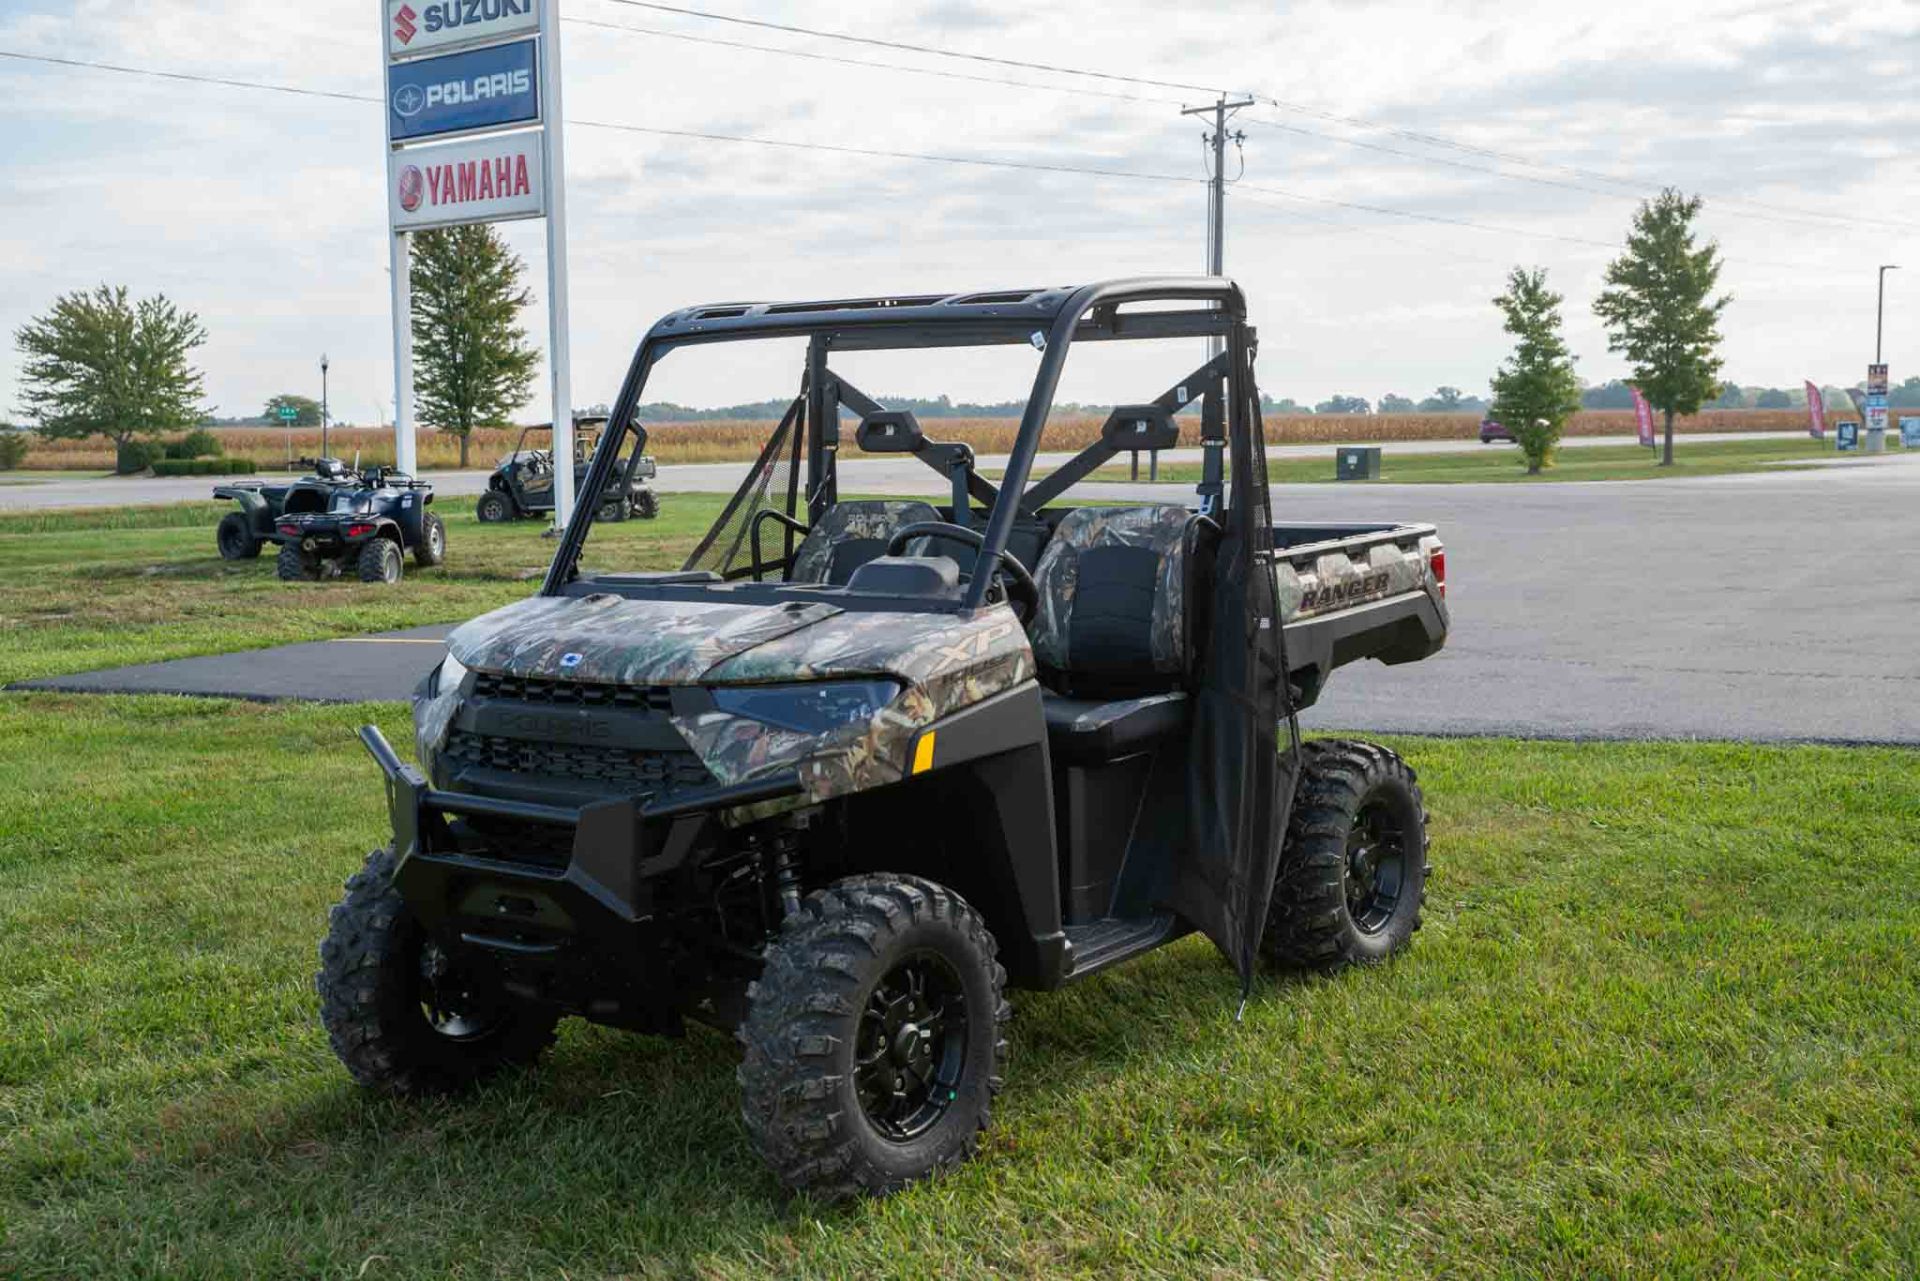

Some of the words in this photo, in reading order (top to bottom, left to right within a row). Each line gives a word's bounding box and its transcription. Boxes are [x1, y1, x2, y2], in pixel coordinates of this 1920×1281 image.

[424, 0, 531, 32] SUZUKI
[427, 69, 529, 108] POLARIS
[426, 154, 530, 206] YAMAHA
[1299, 572, 1391, 611] RANGER
